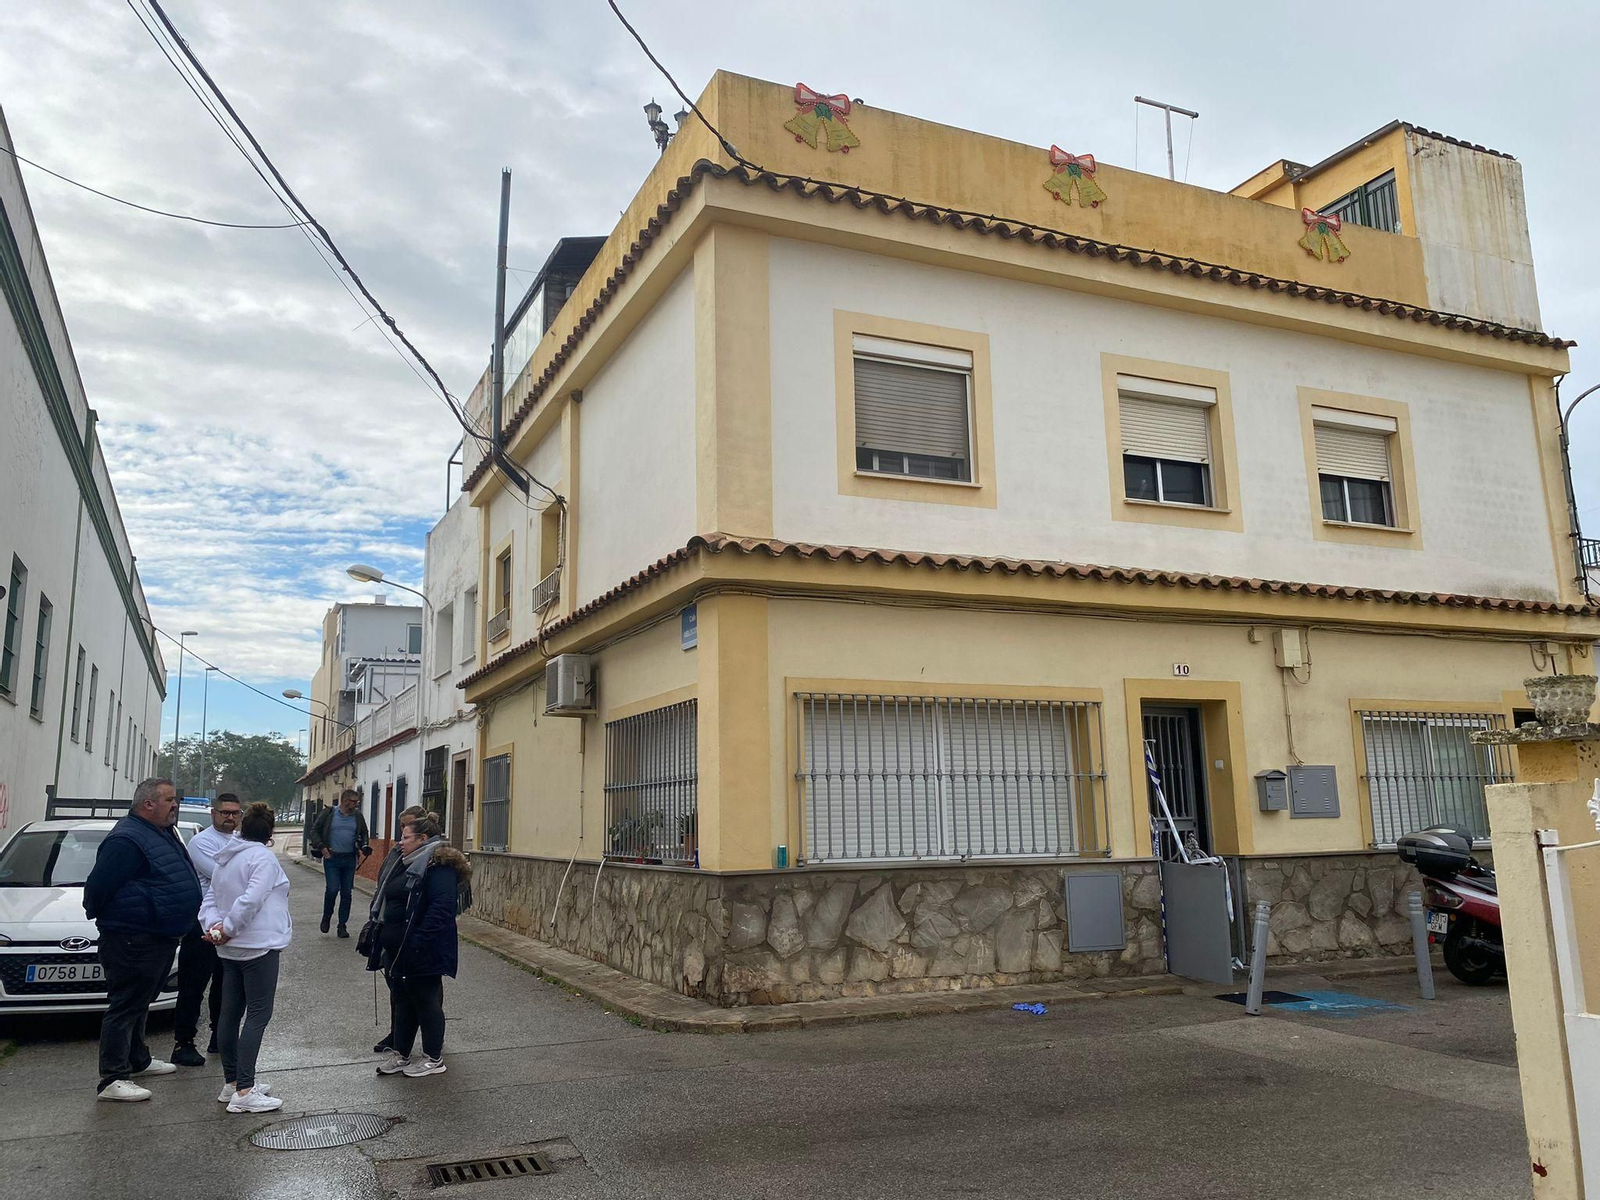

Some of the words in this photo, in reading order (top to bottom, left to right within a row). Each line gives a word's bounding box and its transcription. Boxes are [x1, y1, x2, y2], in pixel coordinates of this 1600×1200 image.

[1175, 664, 1190, 675] 10
[38, 966, 77, 980] 0758
[82, 965, 101, 979] LB
